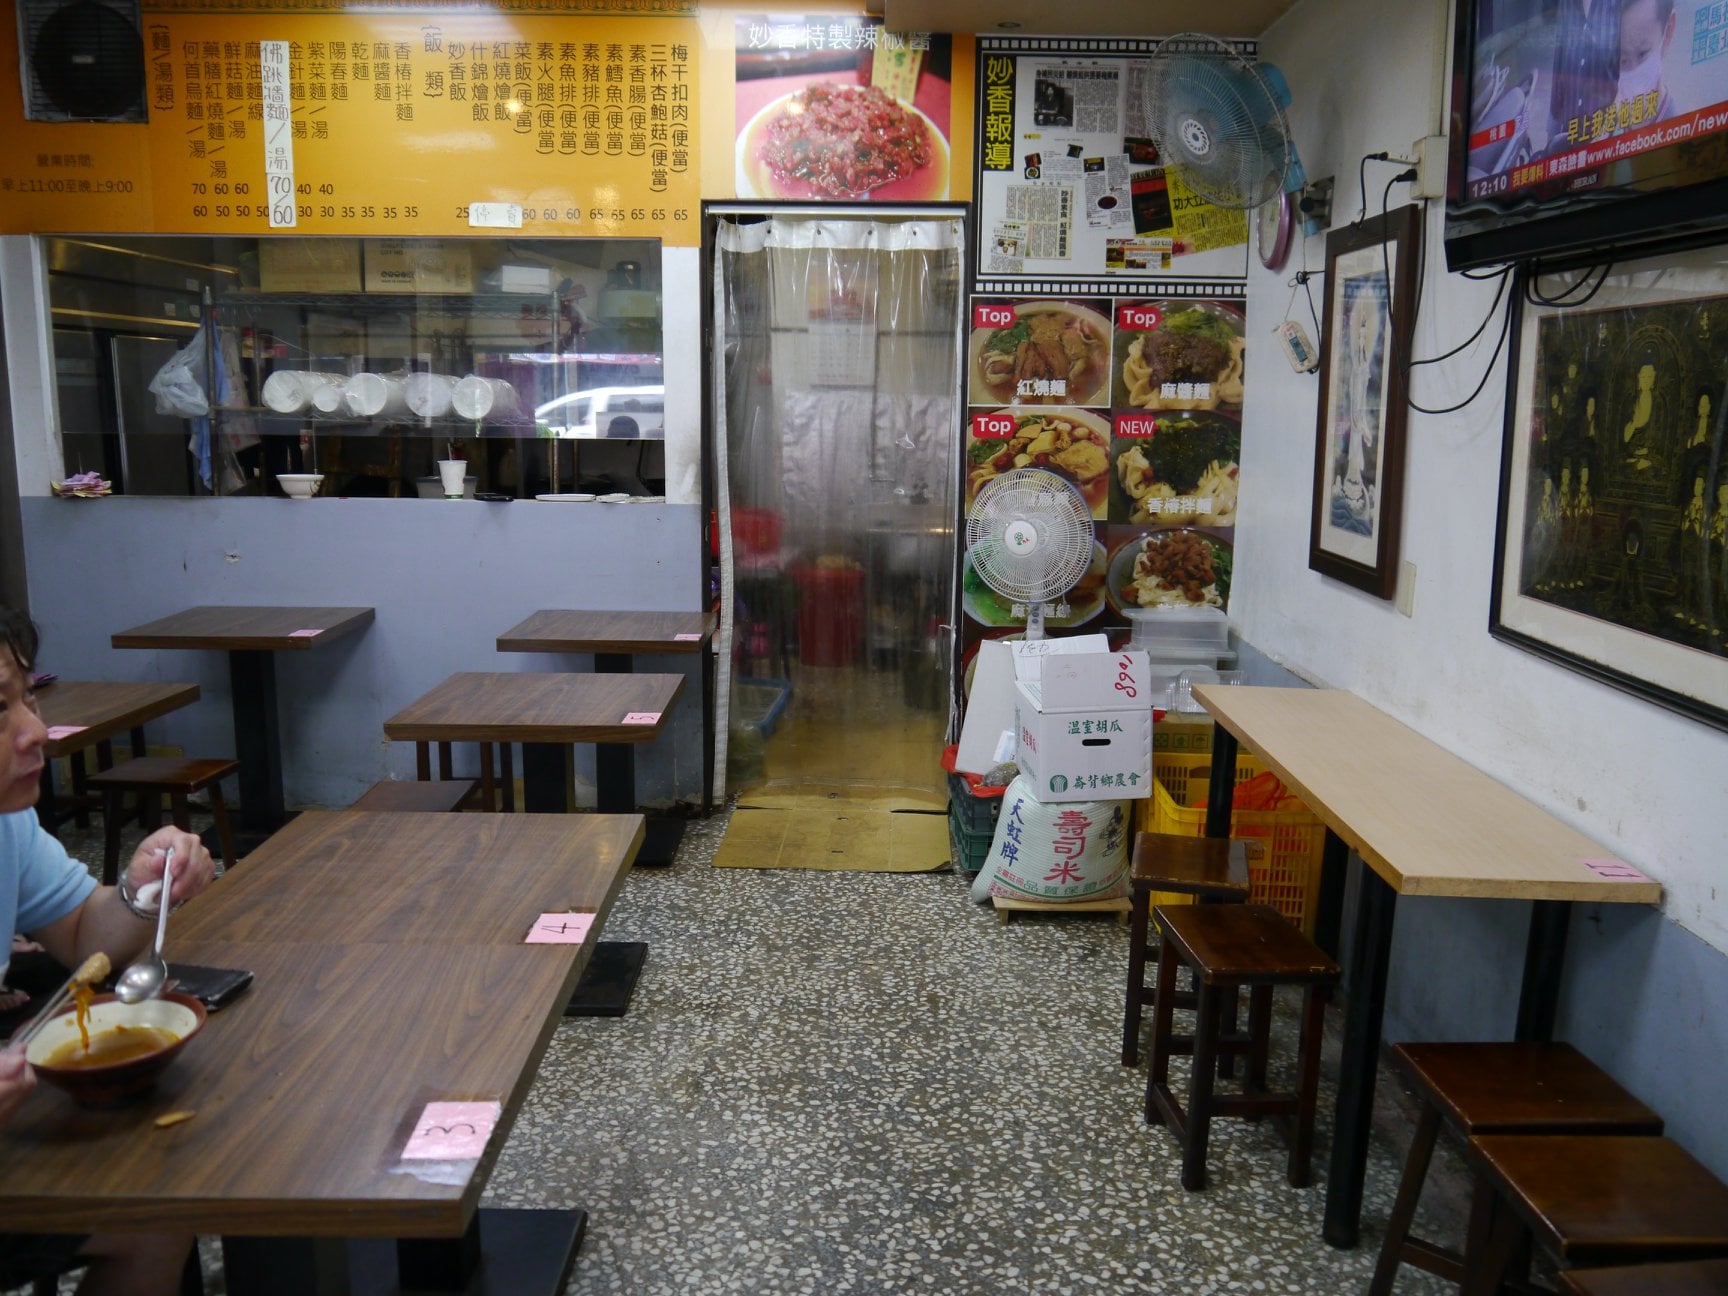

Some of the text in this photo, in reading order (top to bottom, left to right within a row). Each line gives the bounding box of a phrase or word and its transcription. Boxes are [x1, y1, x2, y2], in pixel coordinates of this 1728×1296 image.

[307, 41, 329, 139] 紫菜麵/湯
[329, 41, 349, 101] 陽春麵
[352, 41, 370, 81] 乾麵
[373, 41, 392, 101] 麻醬麵
[394, 42, 414, 122] 香椿拌麵
[448, 42, 467, 102] 妙香飯
[470, 42, 490, 122] 什錦燴飯
[492, 42, 512, 122] 紅燒燴飯
[535, 42, 555, 155] 素火腿(便當)
[557, 42, 577, 156] 素魚排(便當)
[580, 43, 601, 156] 素豬排(便當)
[627, 43, 647, 157] 素香腸(便當)
[649, 44, 669, 193] 三杯杏鮑菇(便當)
[984, 56, 1013, 170] 妙香報導
[192, 183, 334, 195] 70 60 60 40 40
[193, 206, 208, 217] 60
[215, 206, 230, 217] 50
[236, 206, 250, 217] 50
[298, 206, 312, 217] 30
[320, 206, 335, 217] 30
[341, 206, 355, 218] 35
[361, 206, 375, 218] 35
[383, 207, 397, 218] 35
[404, 206, 418, 218] 35
[456, 207, 469, 218] 25
[543, 208, 558, 220] 60
[566, 208, 581, 220] 60
[589, 208, 604, 220] 65
[631, 208, 646, 220] 65
[651, 208, 666, 220] 65
[674, 208, 688, 221] 65
[1472, 175, 1508, 198] 12:10
[979, 308, 1012, 323] Top
[1123, 309, 1157, 325] Top
[1017, 379, 1066, 396] 紅燒麵
[977, 417, 1011, 433] Top
[1120, 419, 1154, 434] NEW
[1043, 811, 1092, 884] 壽司米
